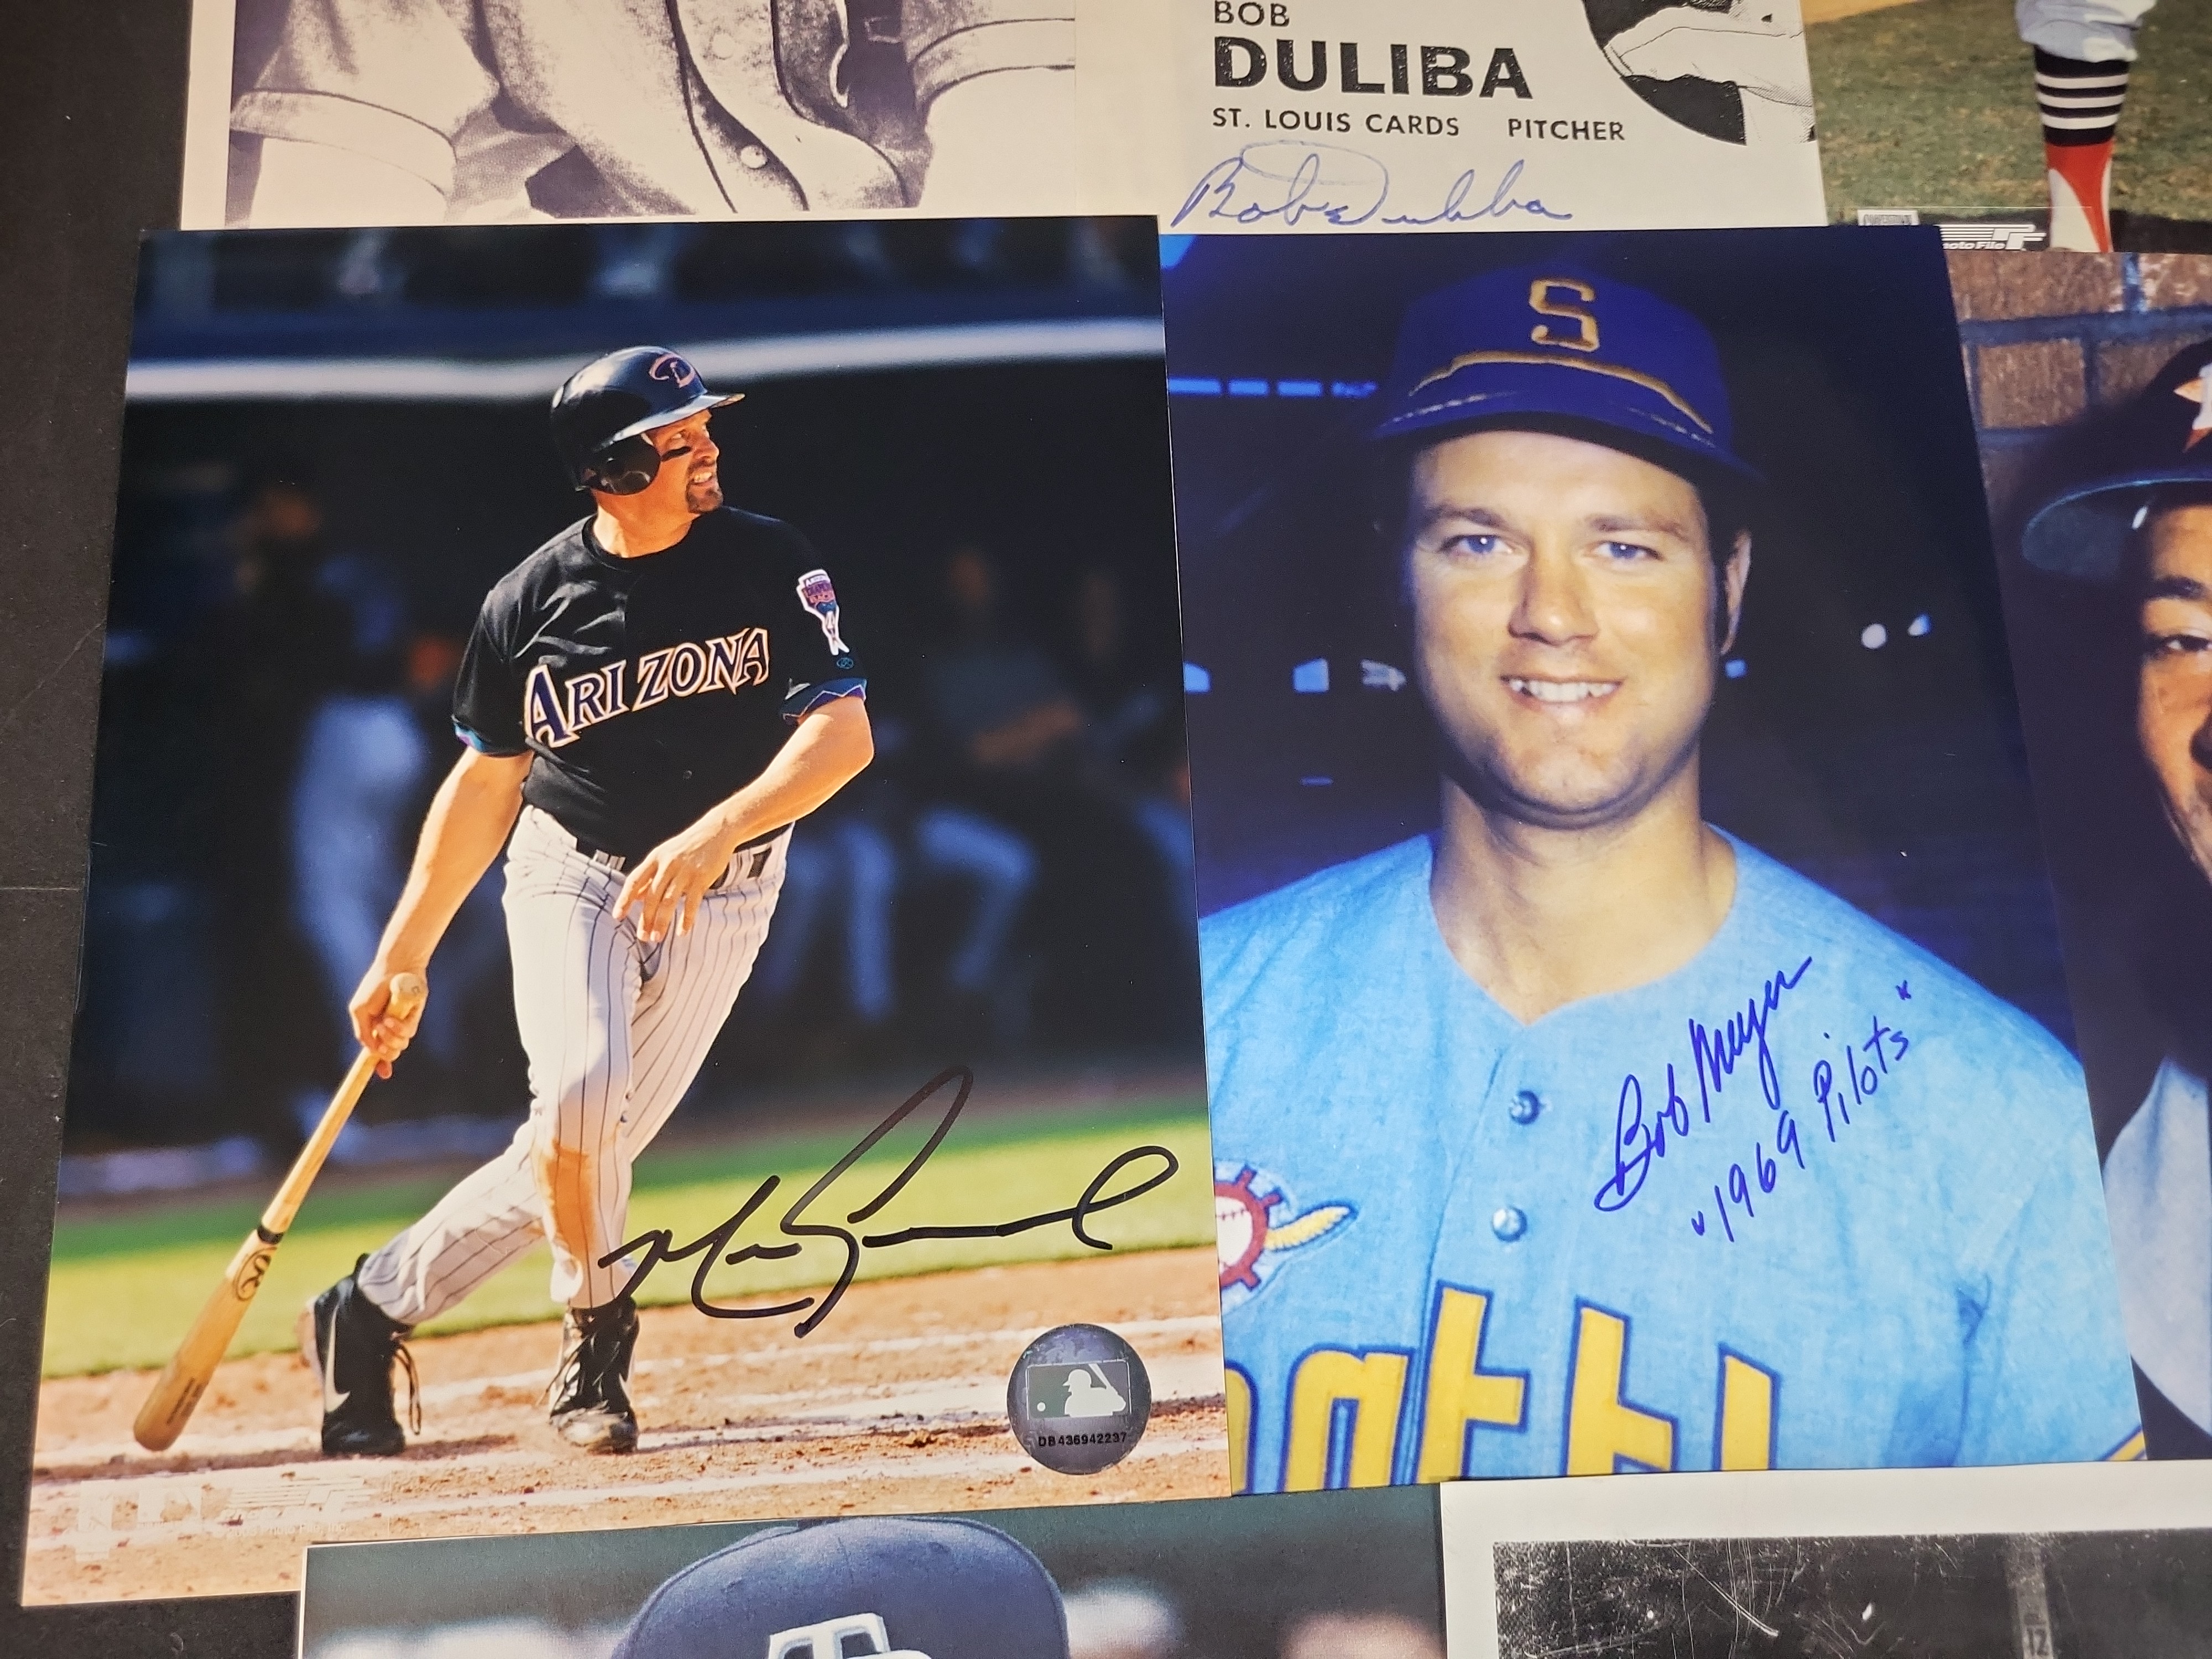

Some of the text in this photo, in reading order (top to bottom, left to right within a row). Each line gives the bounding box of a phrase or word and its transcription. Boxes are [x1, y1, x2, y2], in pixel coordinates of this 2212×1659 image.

[1215, 1, 1290, 27] BOB
[1214, 36, 1533, 100] DULIBA
[1213, 108, 1626, 141] ST. LOUIS CARDS PITCHER
[1528, 276, 1600, 352] S
[524, 628, 769, 748] ARIZONA
[1594, 1063, 1689, 1211] Bob
